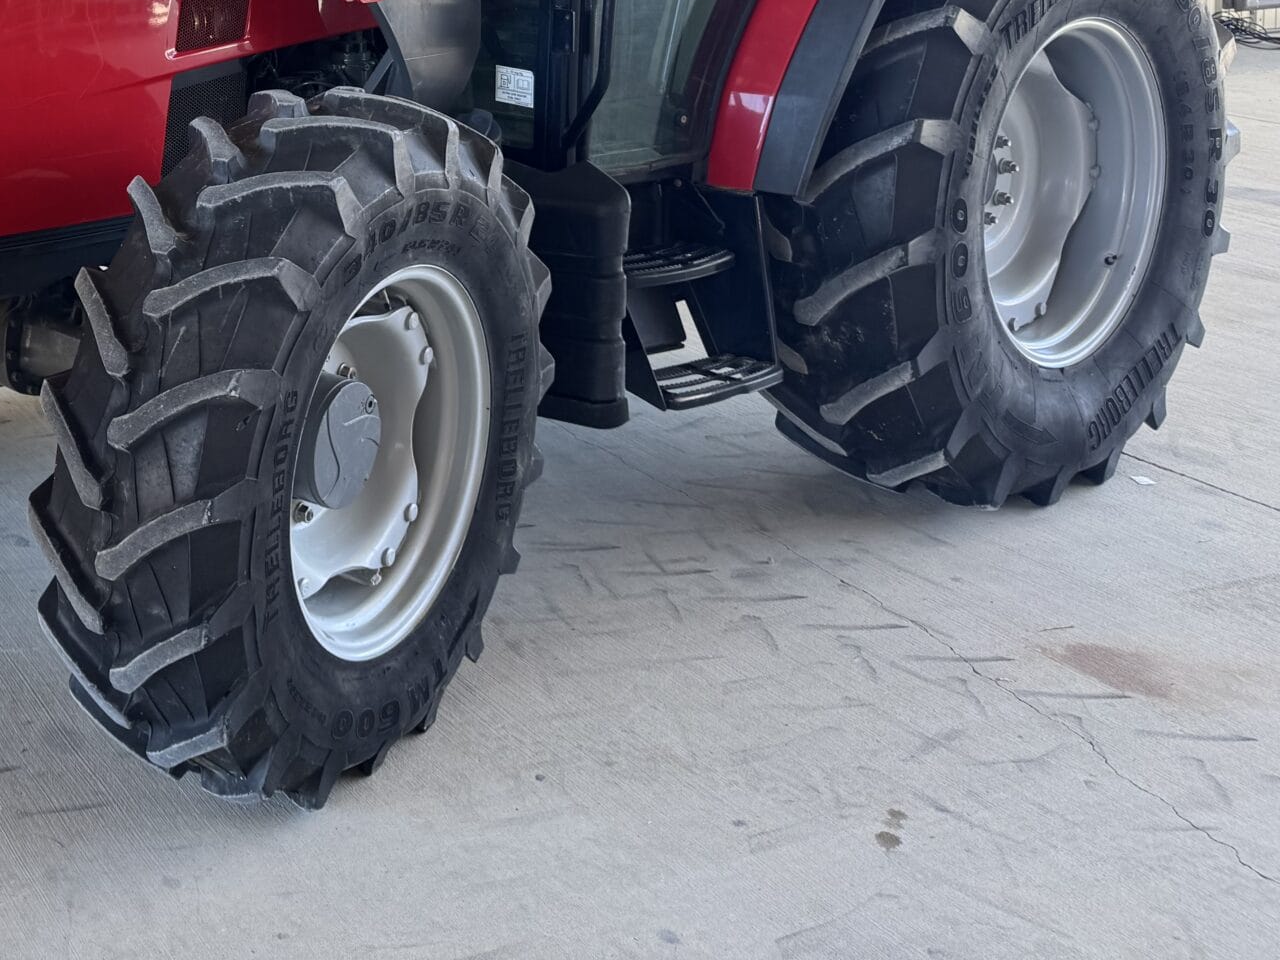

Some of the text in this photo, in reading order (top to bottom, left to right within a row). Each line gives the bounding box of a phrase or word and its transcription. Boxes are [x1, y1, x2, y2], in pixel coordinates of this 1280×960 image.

[495, 331, 528, 522] TRELLEBORG
[1087, 322, 1182, 452] TRELLEBORG
[263, 390, 298, 634] TRELLEBORG
